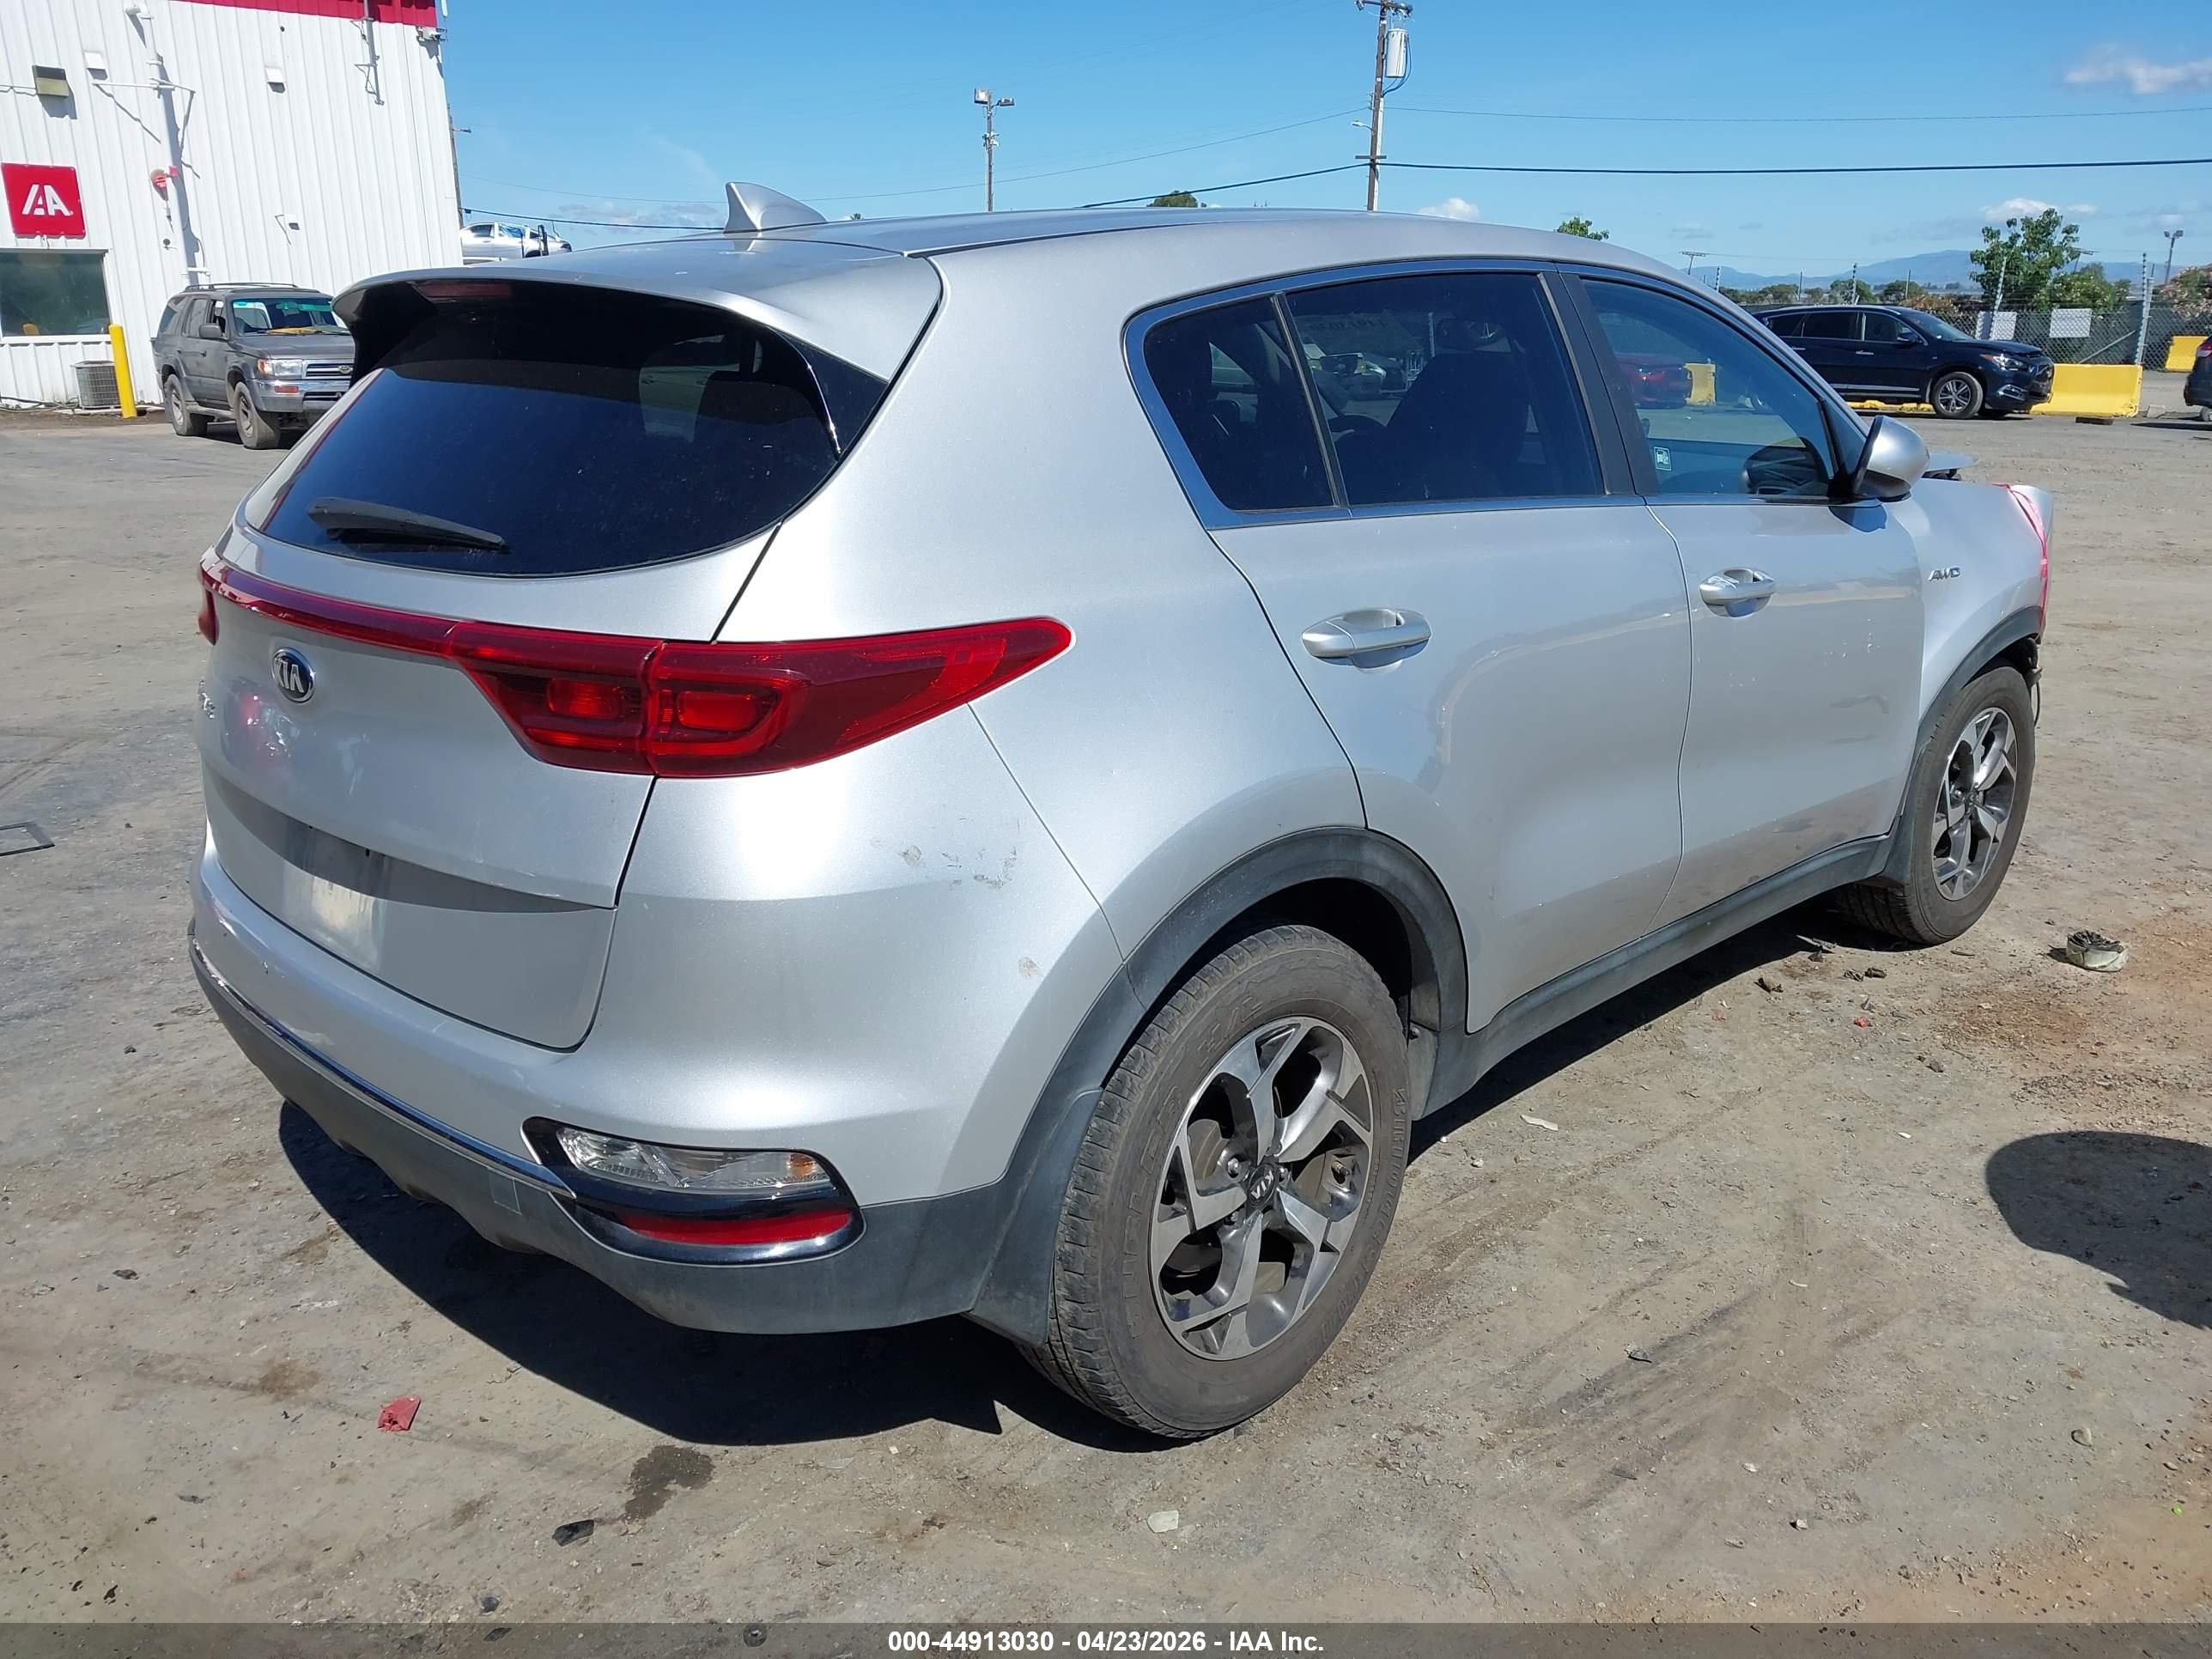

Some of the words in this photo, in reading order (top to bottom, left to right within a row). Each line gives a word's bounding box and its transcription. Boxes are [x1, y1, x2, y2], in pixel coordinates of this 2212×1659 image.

[1927, 566, 1961, 582] AWD
[274, 657, 305, 694] KIA
[1250, 1169, 1274, 1200] KIA
